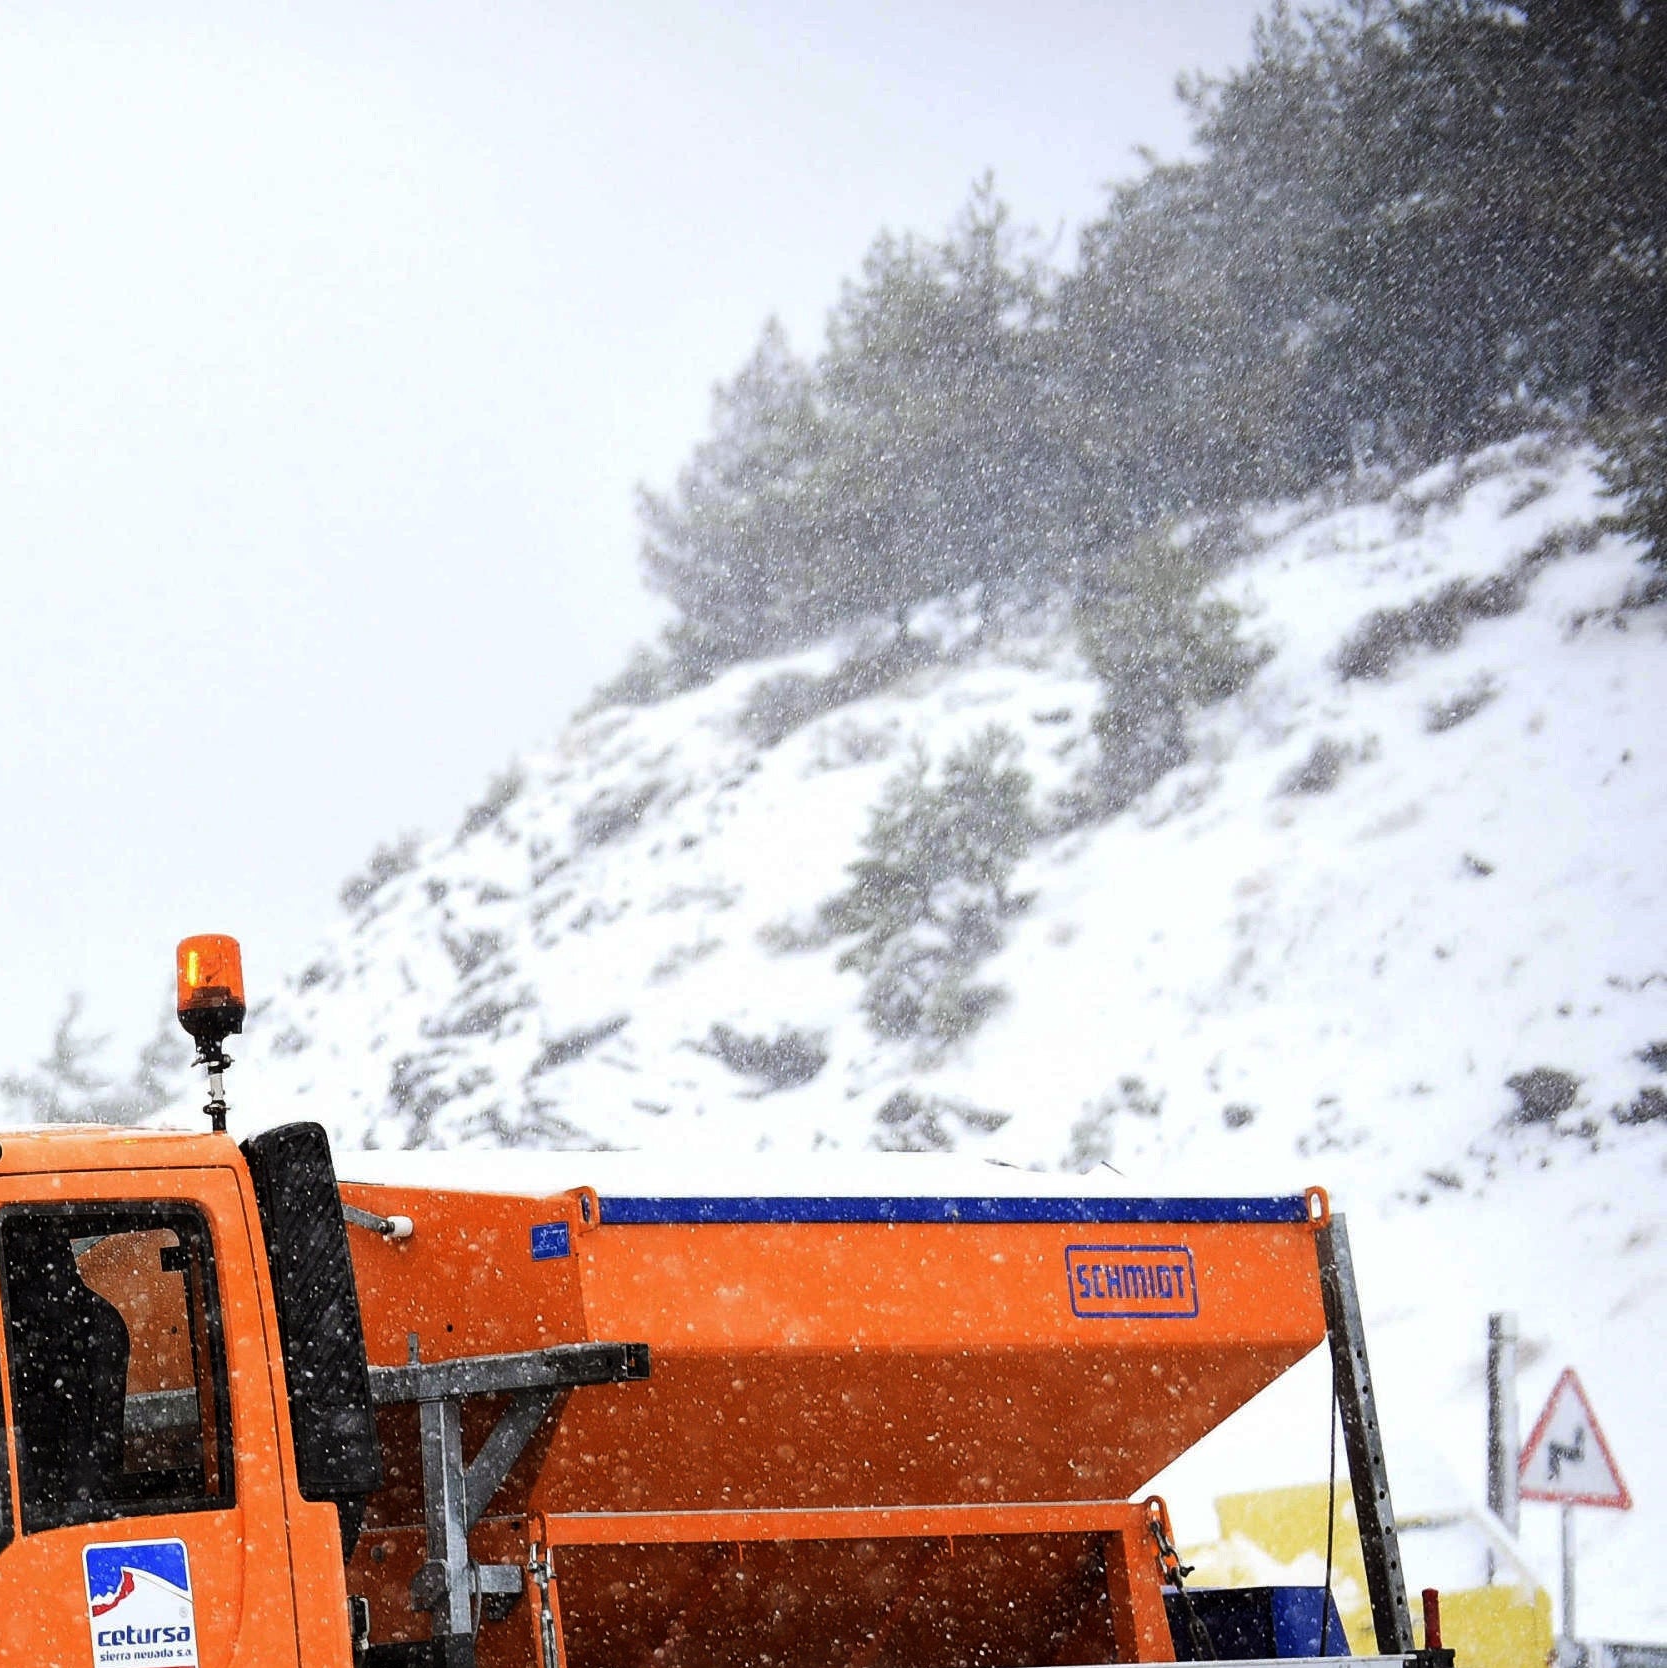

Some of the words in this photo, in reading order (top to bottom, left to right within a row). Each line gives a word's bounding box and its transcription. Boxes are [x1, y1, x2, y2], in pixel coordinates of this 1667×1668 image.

[1076, 1264, 1185, 1298] SCHMIDT
[97, 1625, 191, 1647] cetursa
[100, 1651, 131, 1662] sierra
